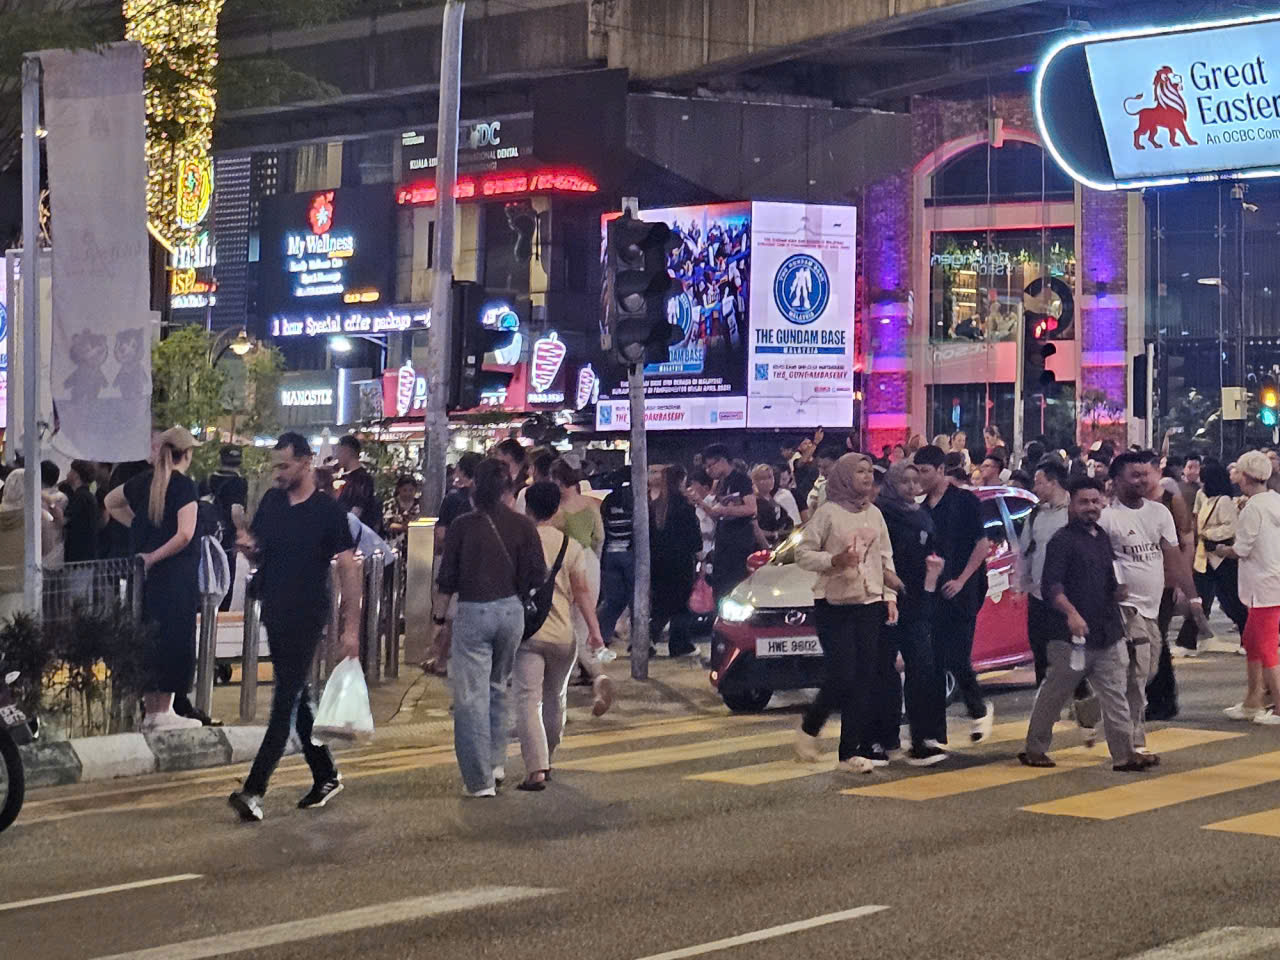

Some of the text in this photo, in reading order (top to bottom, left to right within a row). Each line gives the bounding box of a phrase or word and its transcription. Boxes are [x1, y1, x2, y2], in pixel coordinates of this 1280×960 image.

[1190, 54, 1268, 91] Great
[1206, 132, 1221, 145] An
[1222, 128, 1256, 143] OCBC
[306, 315, 342, 337] Special
[755, 328, 846, 346] THE GUNDAM BASE
